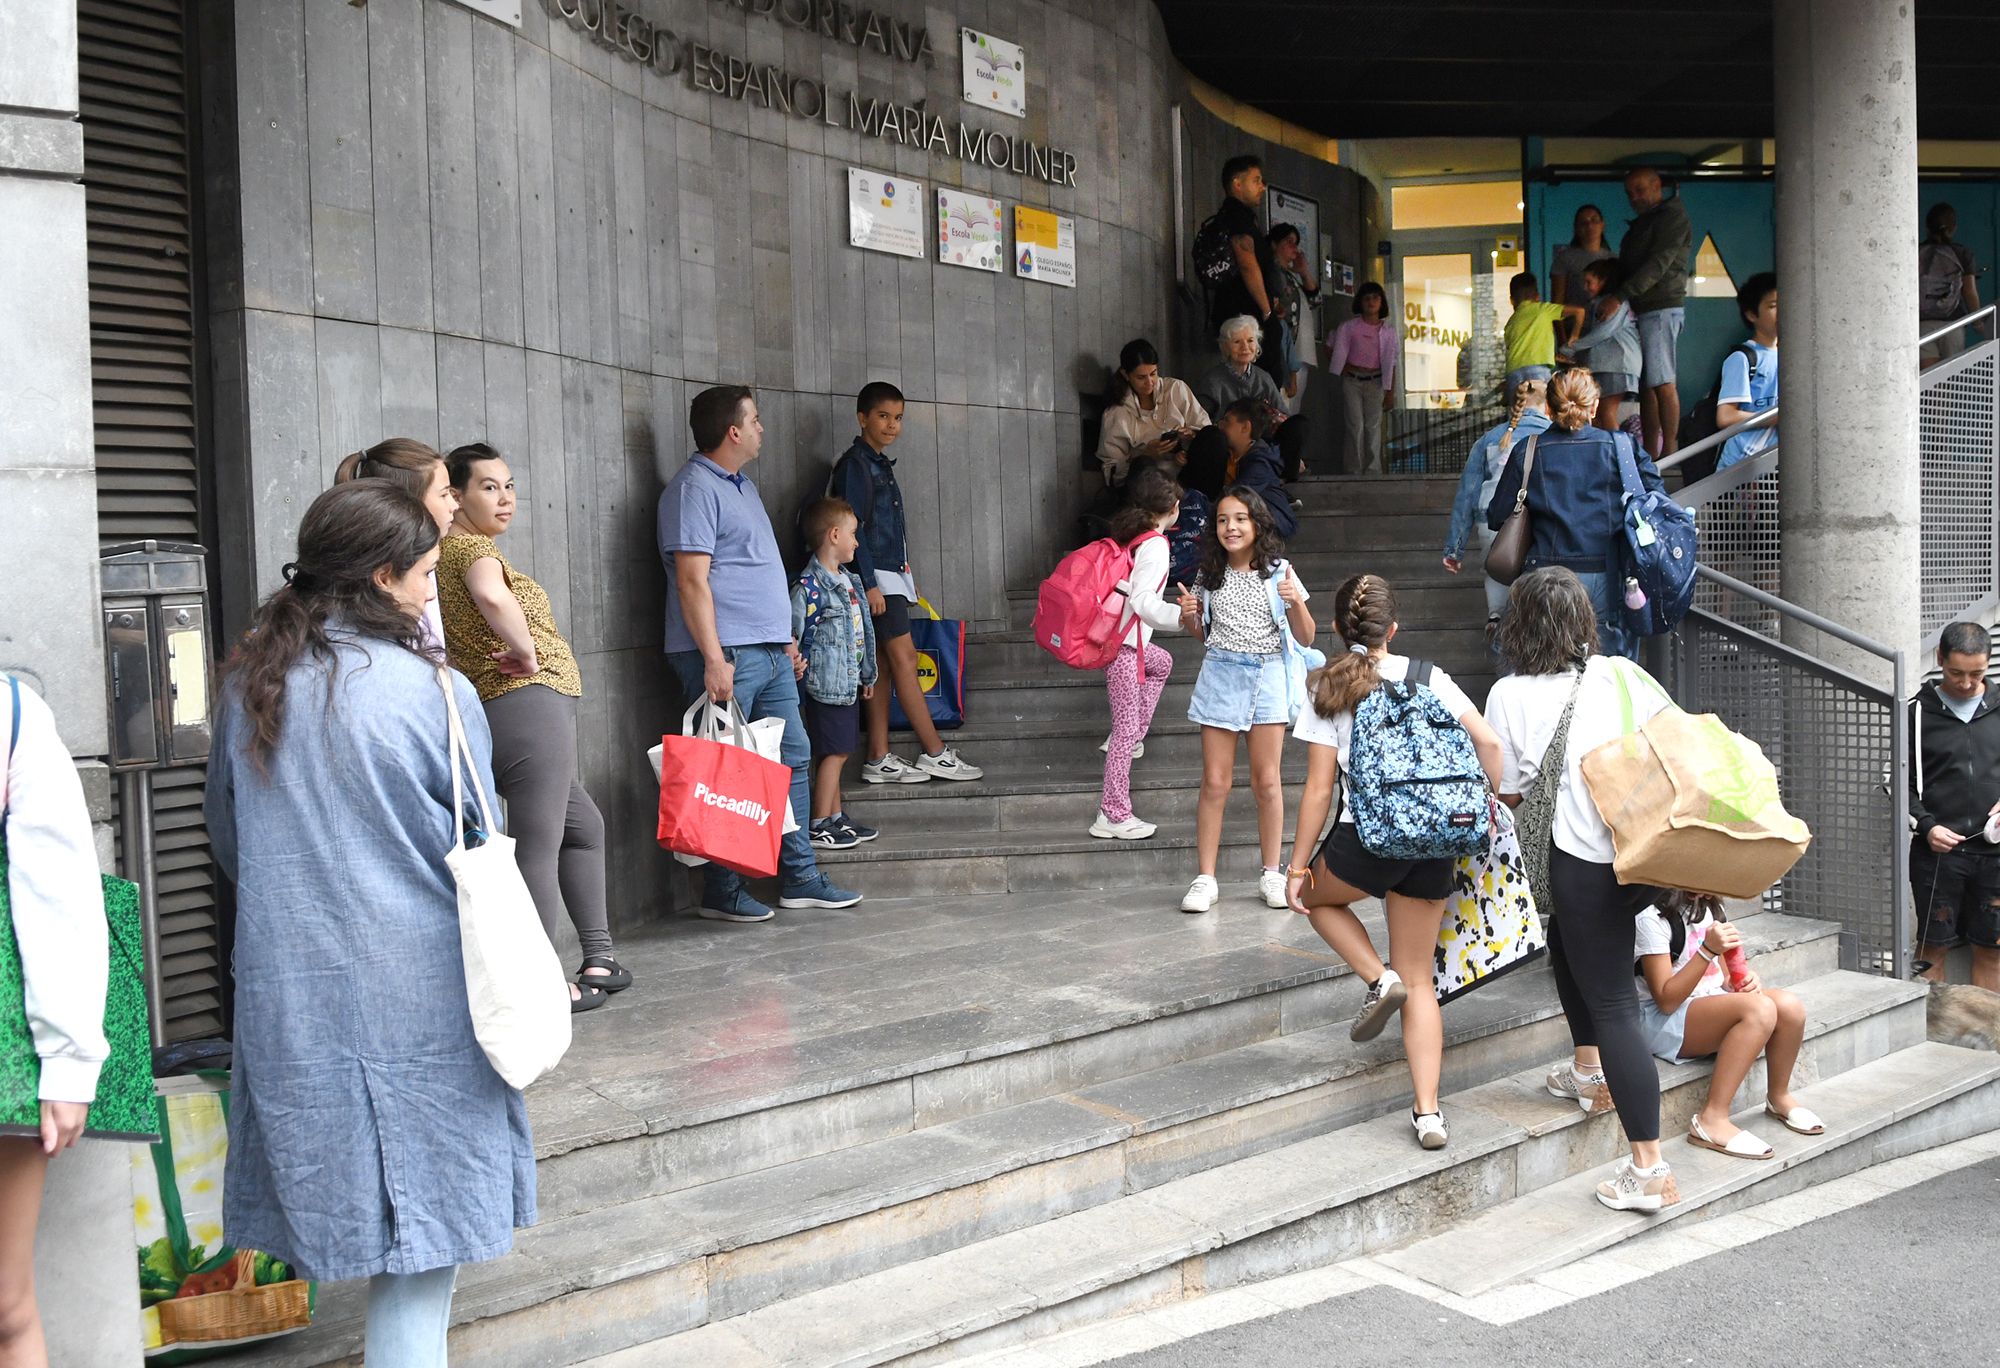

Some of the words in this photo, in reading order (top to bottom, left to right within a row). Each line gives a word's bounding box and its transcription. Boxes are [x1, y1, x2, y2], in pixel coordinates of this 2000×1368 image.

[976, 67, 995, 81] Escola
[960, 121, 1078, 188] MOLINER
[951, 227, 970, 239] Escola
[1206, 261, 1230, 278] FILA
[917, 668, 935, 677] DL
[694, 782, 771, 826] Piccadilly
